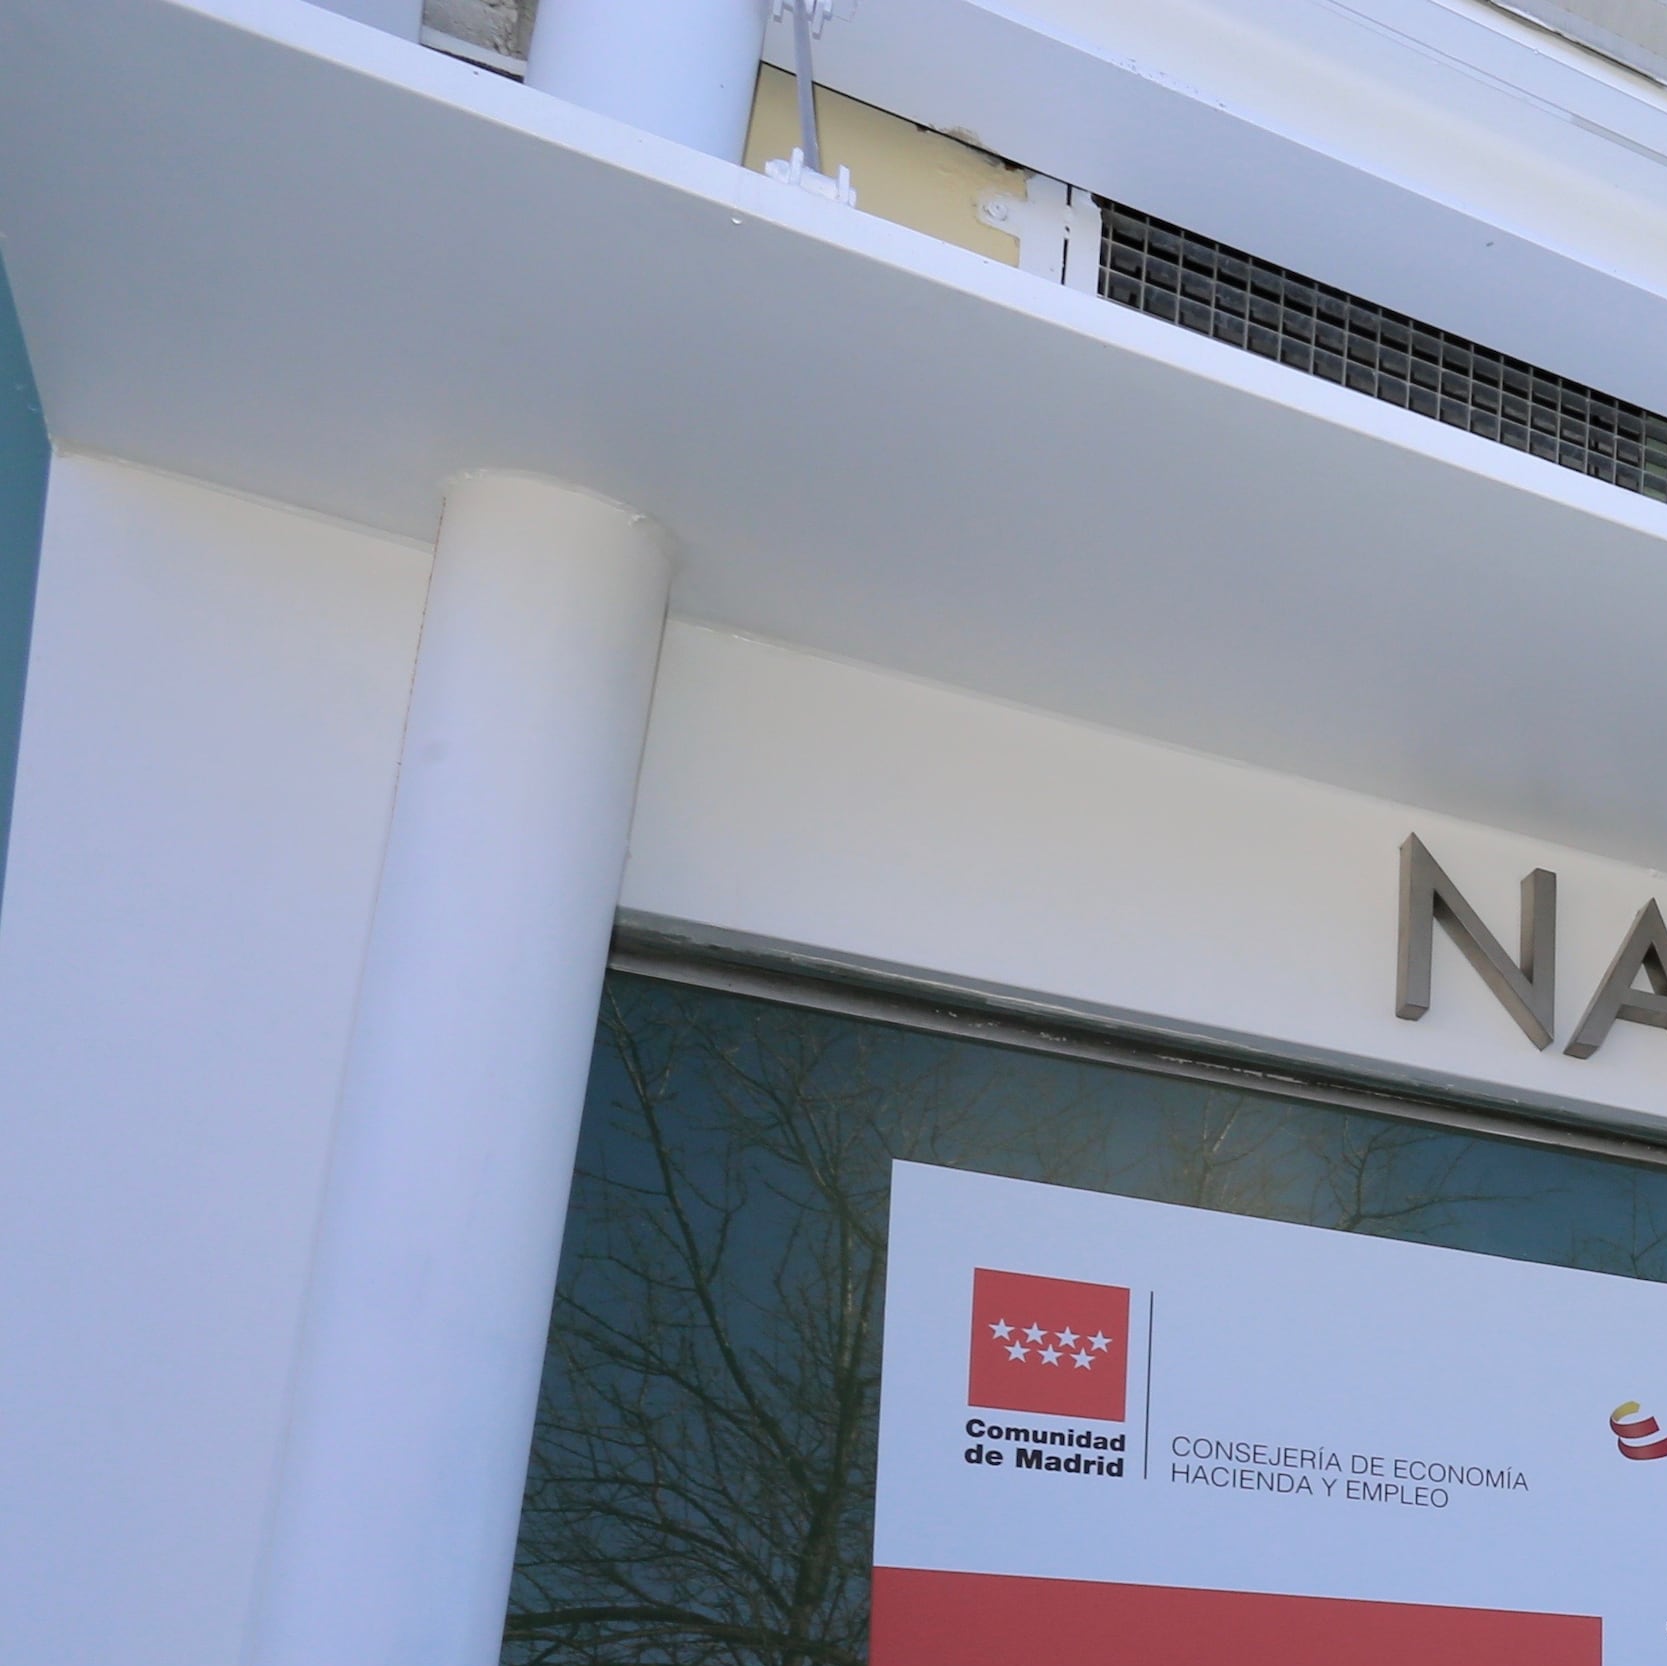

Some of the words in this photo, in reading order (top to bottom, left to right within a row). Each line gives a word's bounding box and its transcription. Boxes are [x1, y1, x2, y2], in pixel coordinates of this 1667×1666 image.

[965, 1418, 1126, 1453] Comunidad
[964, 1443, 1003, 1466] de
[1015, 1447, 1124, 1478] Madrid
[1171, 1435, 1341, 1473] CONSEJERÍA
[1352, 1455, 1385, 1477] DE
[1394, 1459, 1529, 1492] ECONOMÍA
[1171, 1463, 1313, 1496] HACIENDA
[1322, 1477, 1338, 1498] Y
[1347, 1480, 1449, 1509] EMPLEO
